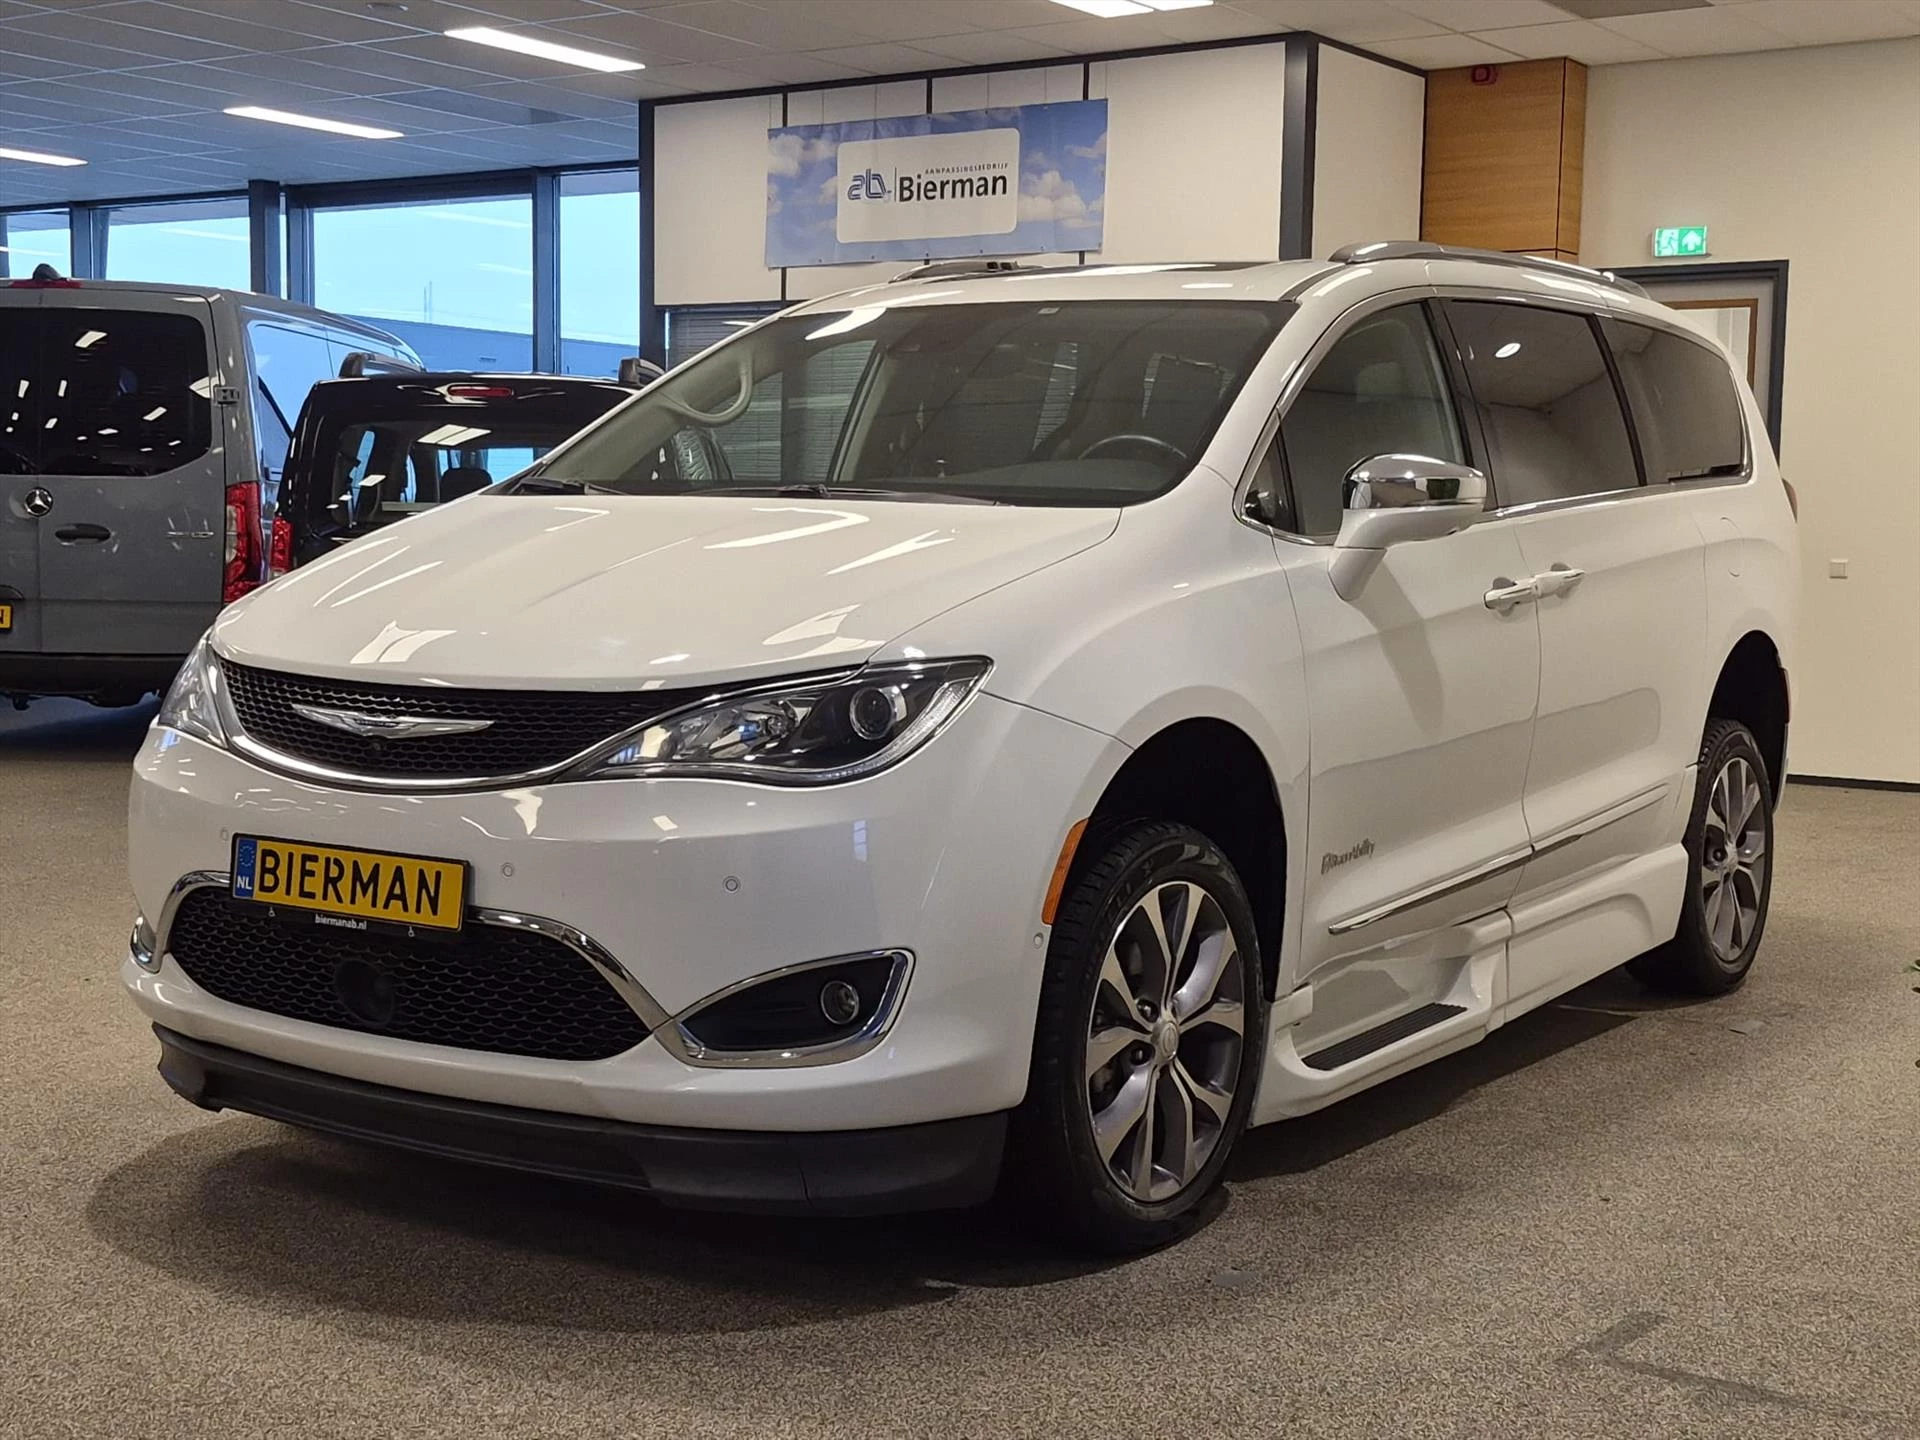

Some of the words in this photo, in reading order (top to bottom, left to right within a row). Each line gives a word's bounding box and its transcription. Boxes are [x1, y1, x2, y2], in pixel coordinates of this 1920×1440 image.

[898, 173, 1008, 203] Bierman
[236, 875, 253, 891] NL
[258, 847, 442, 917] BIERMAN
[314, 913, 368, 931] biermanab.nl
